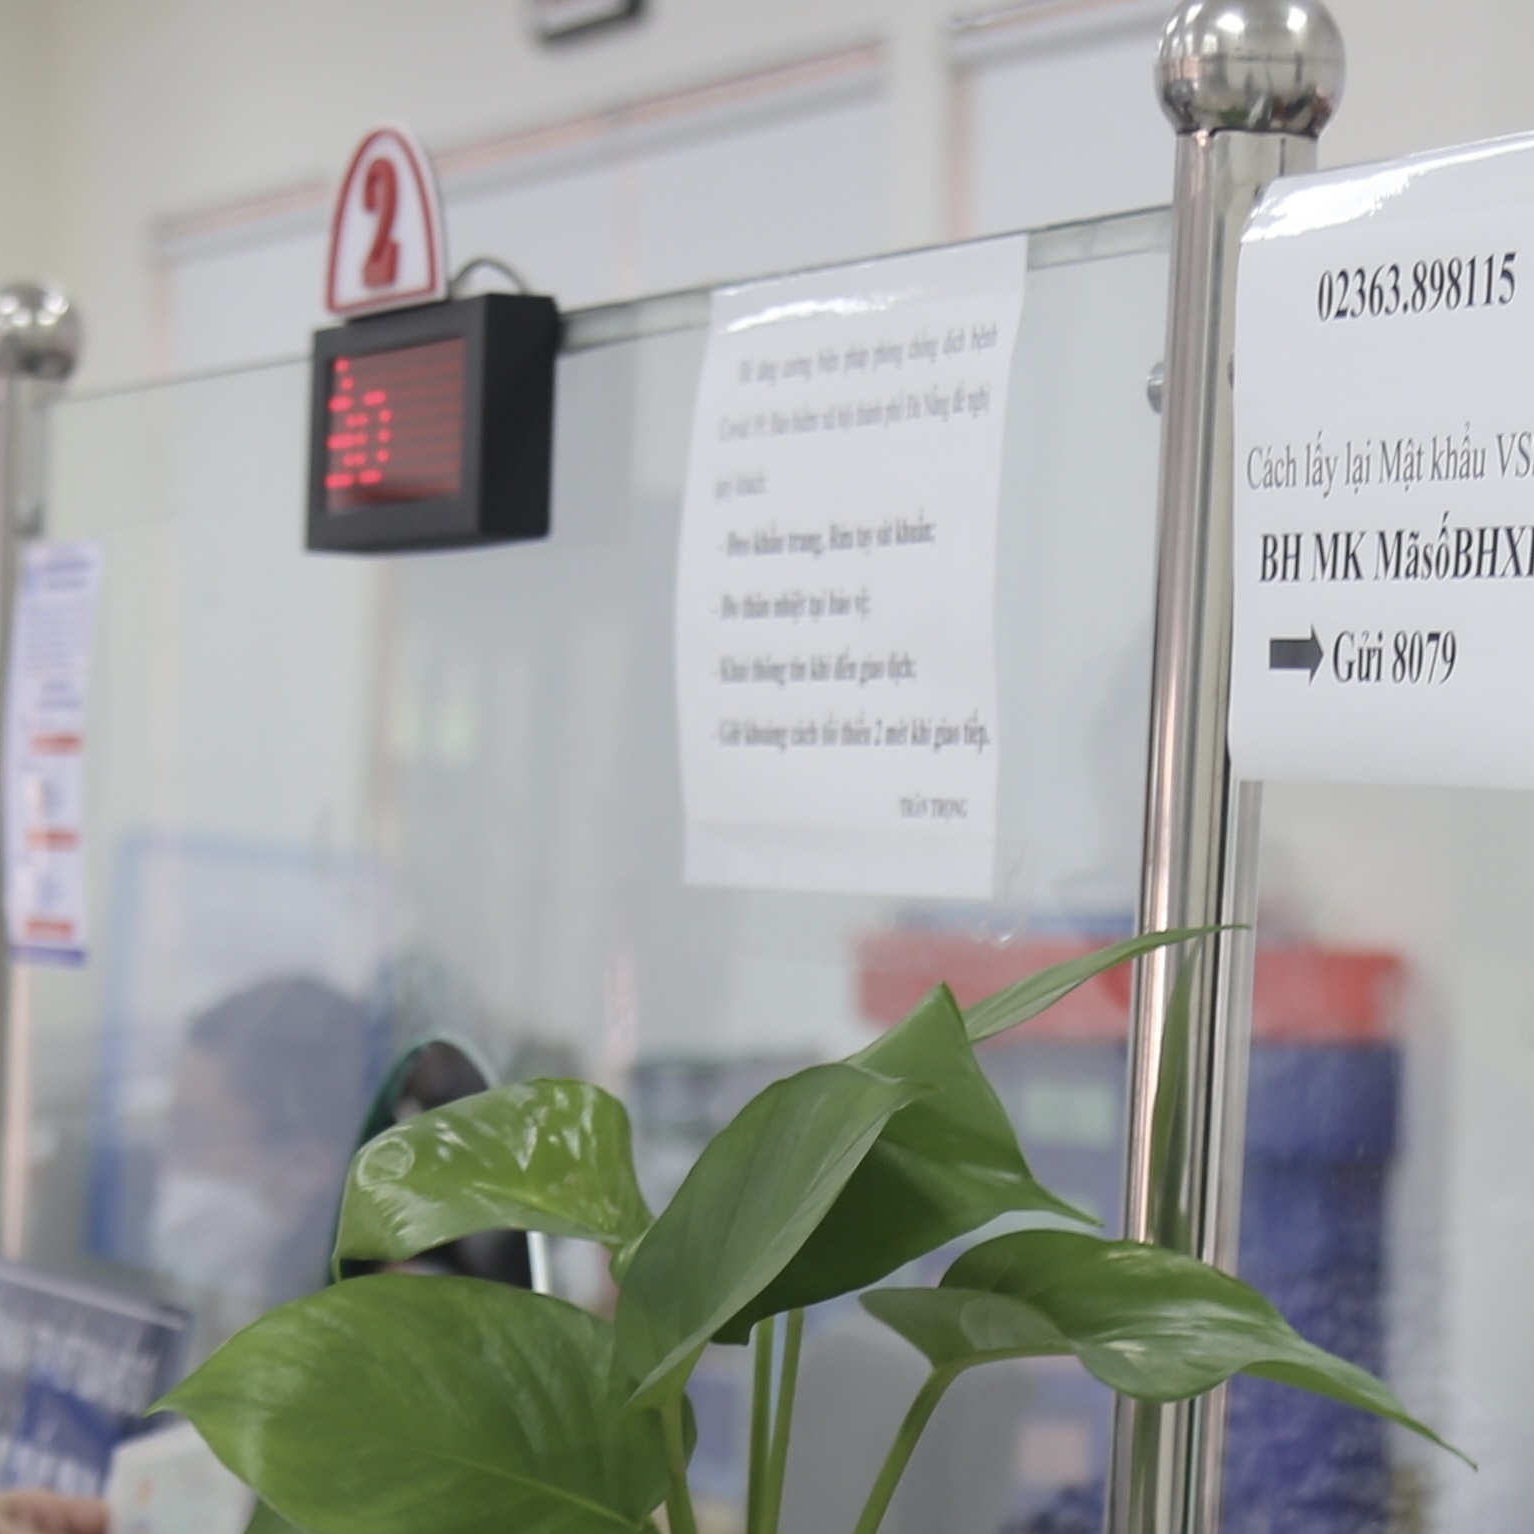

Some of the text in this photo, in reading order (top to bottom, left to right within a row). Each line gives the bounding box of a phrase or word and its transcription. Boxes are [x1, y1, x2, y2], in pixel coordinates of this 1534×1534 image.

[363, 160, 399, 288] 2
[1316, 251, 1516, 322] 02363.898115
[1246, 444, 1298, 491] Cách
[1302, 430, 1340, 499] lấy
[1344, 438, 1373, 498] lại
[1377, 438, 1425, 496] Mật
[1430, 419, 1486, 481] khẩu
[1258, 531, 1302, 584] BH
[1309, 528, 1365, 583] MK
[1331, 628, 1458, 685] Gửi 8079
